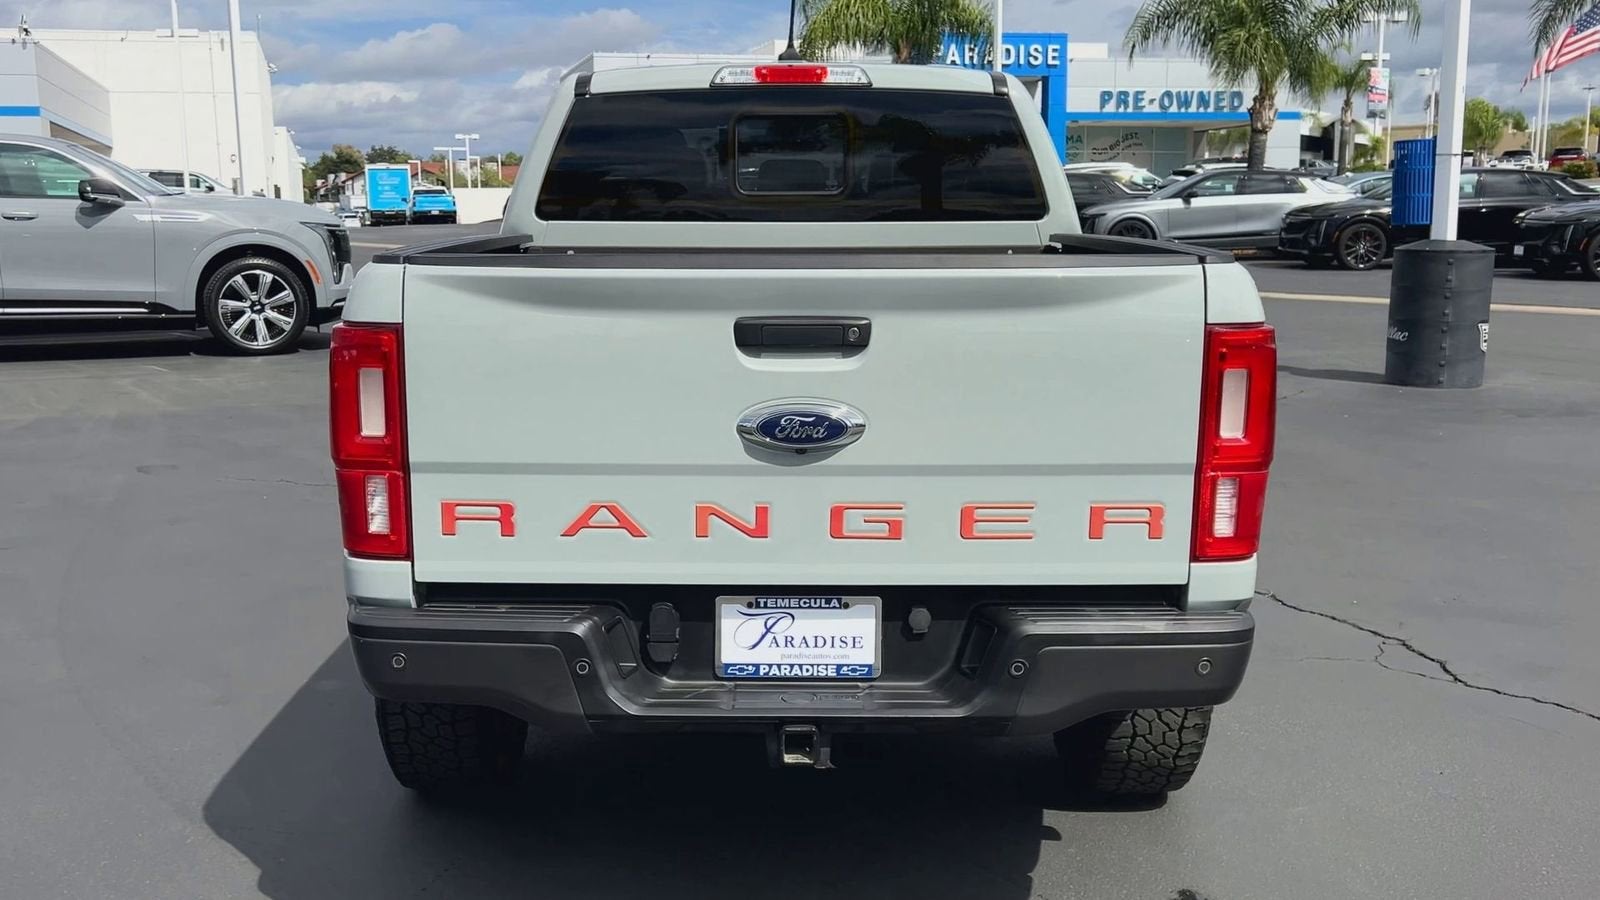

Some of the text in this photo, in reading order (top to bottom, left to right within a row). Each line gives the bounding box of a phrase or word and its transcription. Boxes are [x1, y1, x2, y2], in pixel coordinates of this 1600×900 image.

[1099, 89, 1244, 112] PRE-OWNED
[775, 415, 829, 438] Ford
[440, 500, 1165, 541] RANGER
[757, 598, 840, 608] TEMECULA
[734, 609, 864, 651] PARADISE
[759, 664, 837, 677] PARADISE
